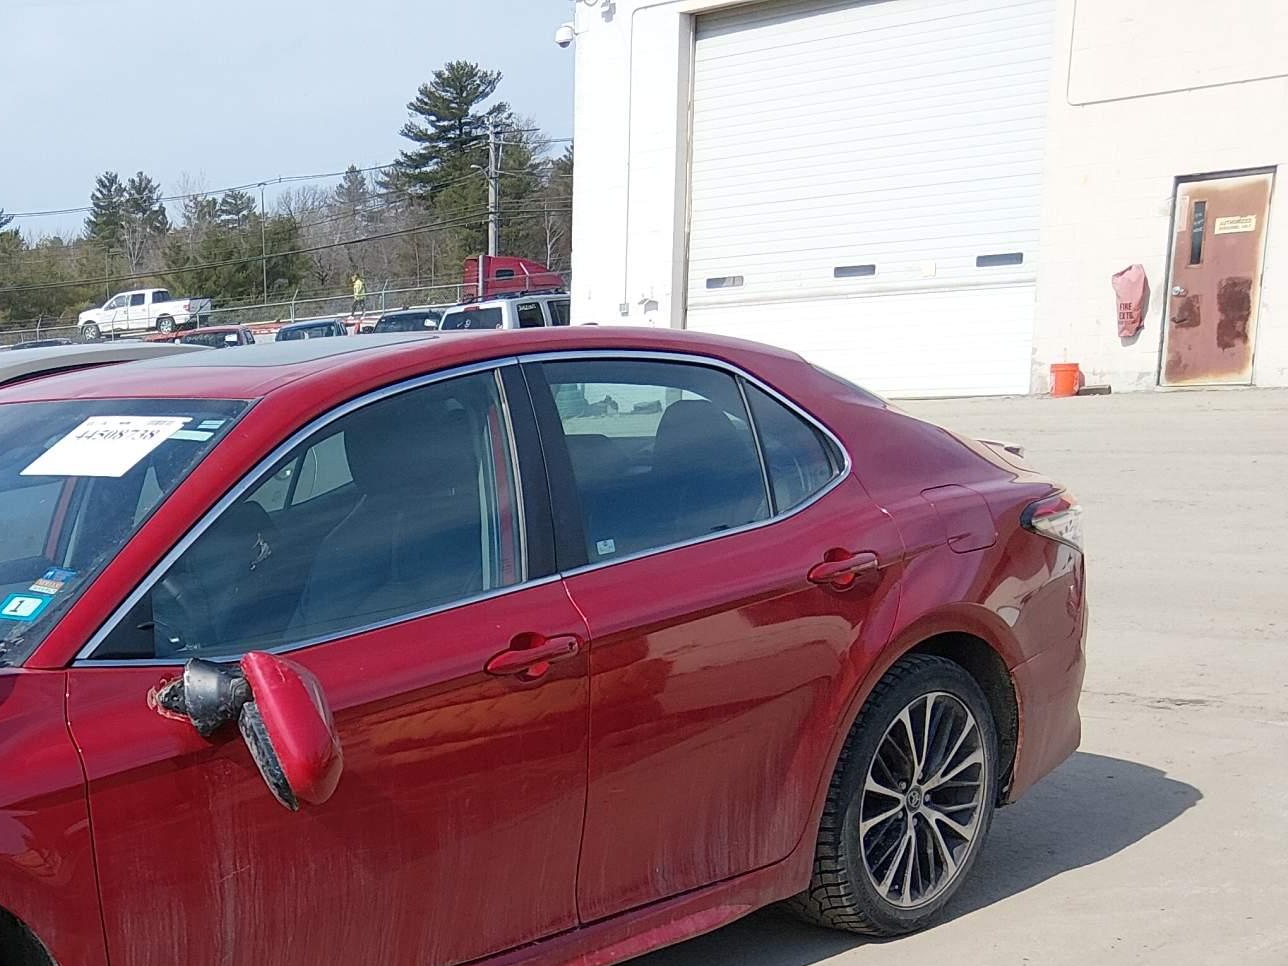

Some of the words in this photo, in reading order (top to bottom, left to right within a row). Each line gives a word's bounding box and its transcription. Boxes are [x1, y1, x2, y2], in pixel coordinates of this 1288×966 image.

[1119, 302, 1133, 311] FIRE
[75, 429, 161, 441] 44508738
[9, 599, 25, 613] 1
